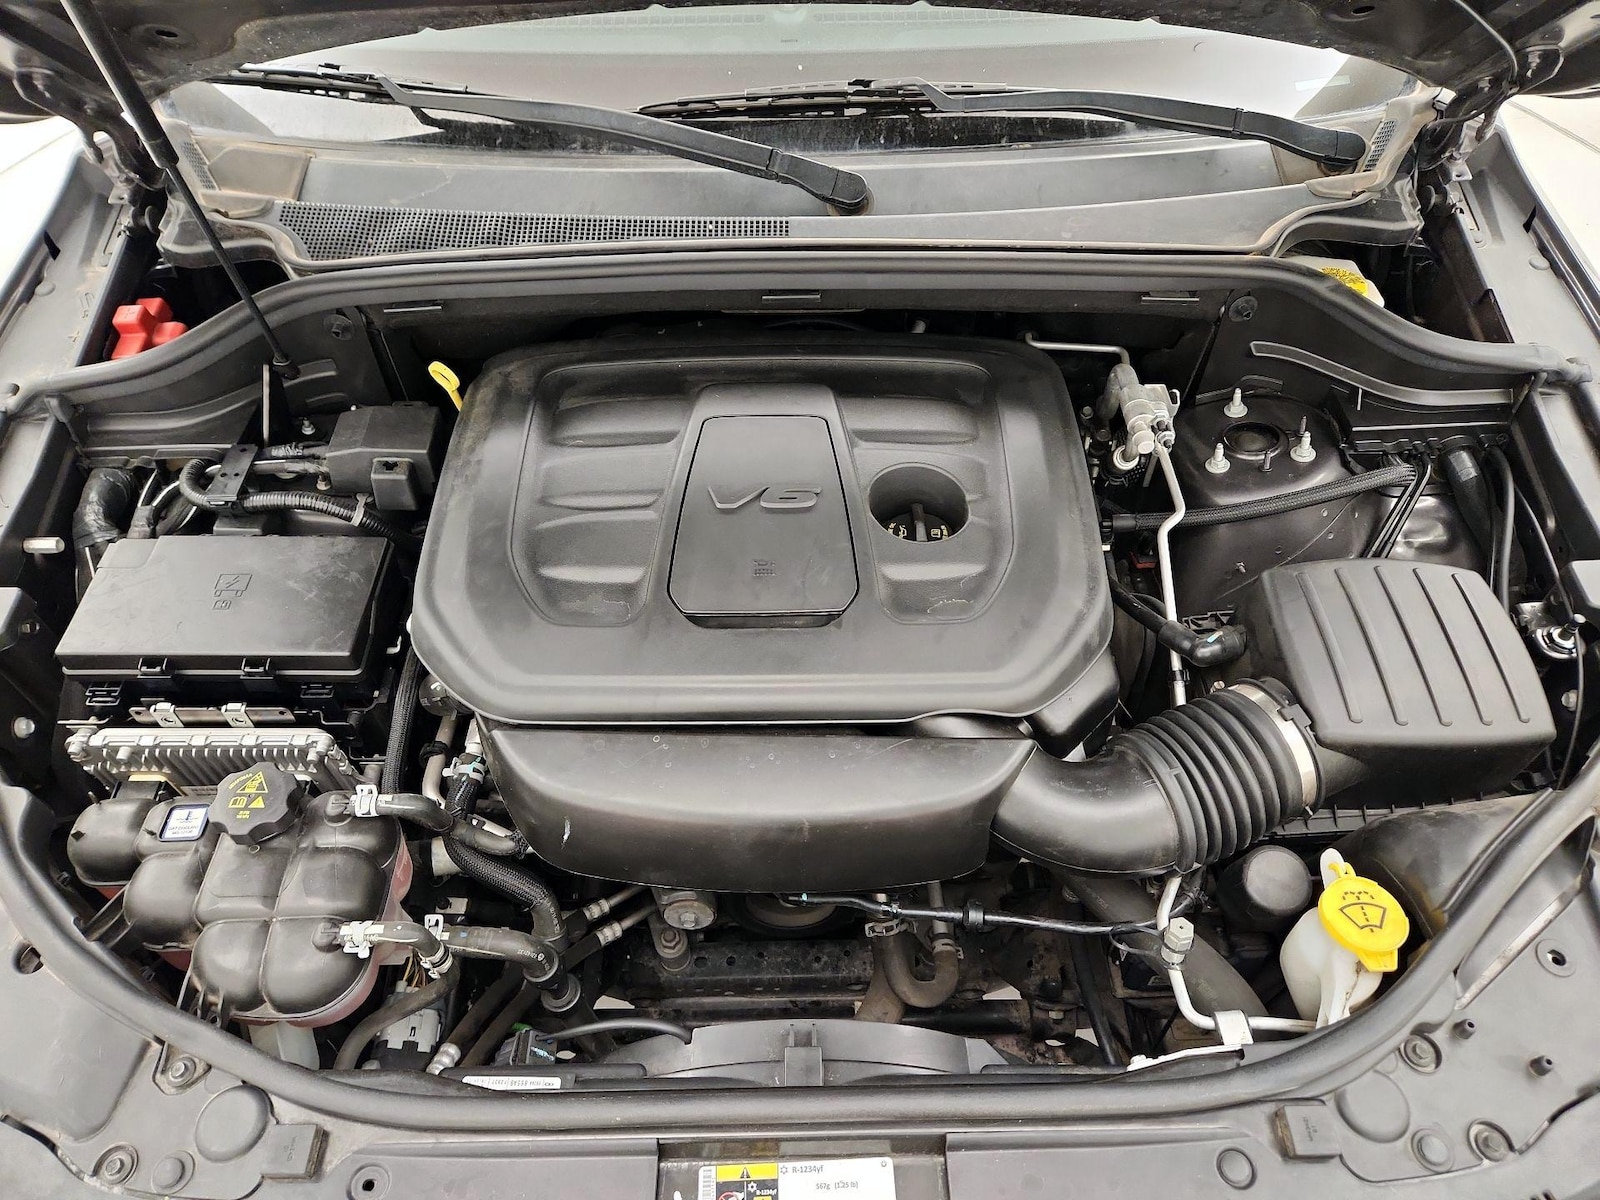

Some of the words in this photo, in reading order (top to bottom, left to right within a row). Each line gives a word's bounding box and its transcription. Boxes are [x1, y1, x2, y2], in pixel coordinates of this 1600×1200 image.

[707, 486, 823, 509] V6
[792, 1165, 824, 1174] R-1234yf
[816, 1182, 831, 1190] 567g
